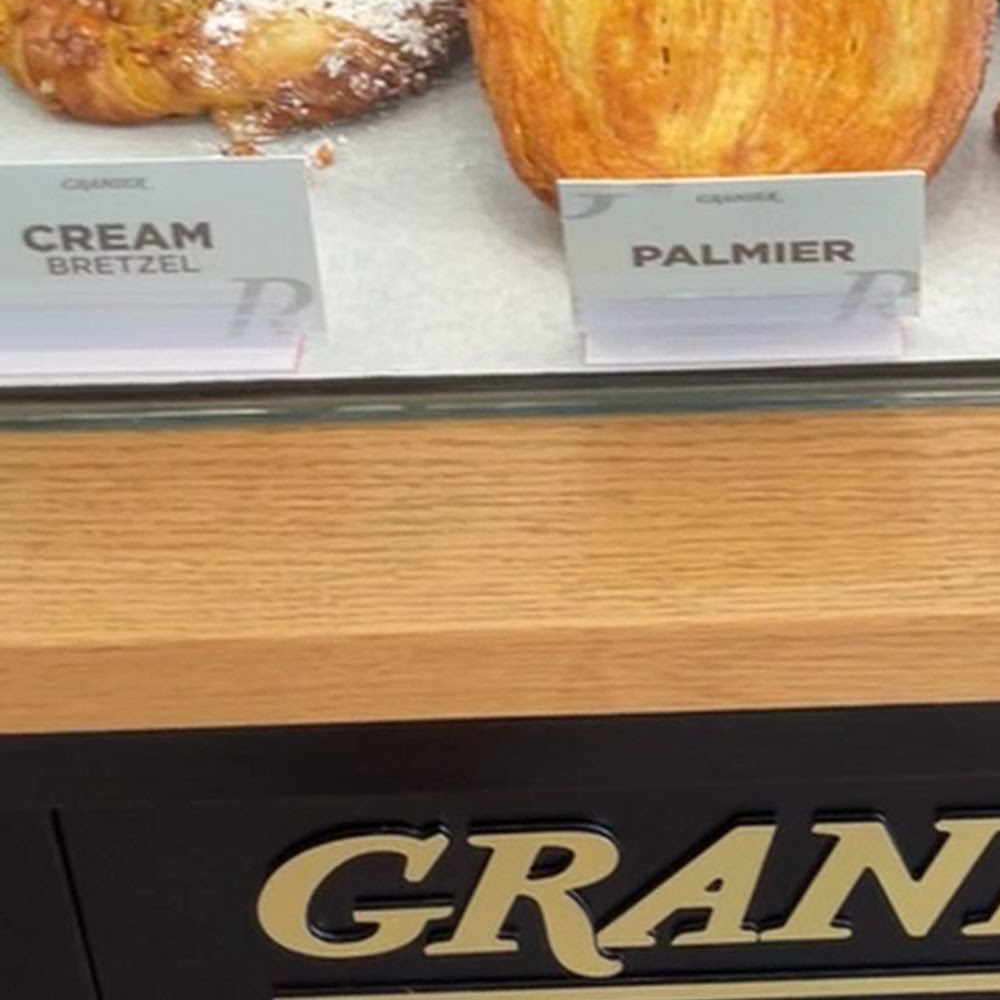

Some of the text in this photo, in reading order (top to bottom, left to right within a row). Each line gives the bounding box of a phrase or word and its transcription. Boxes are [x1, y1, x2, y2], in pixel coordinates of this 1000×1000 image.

[22, 222, 214, 252] CREAM
[48, 254, 200, 276] BRETZEL
[632, 240, 855, 268] PALMIER
